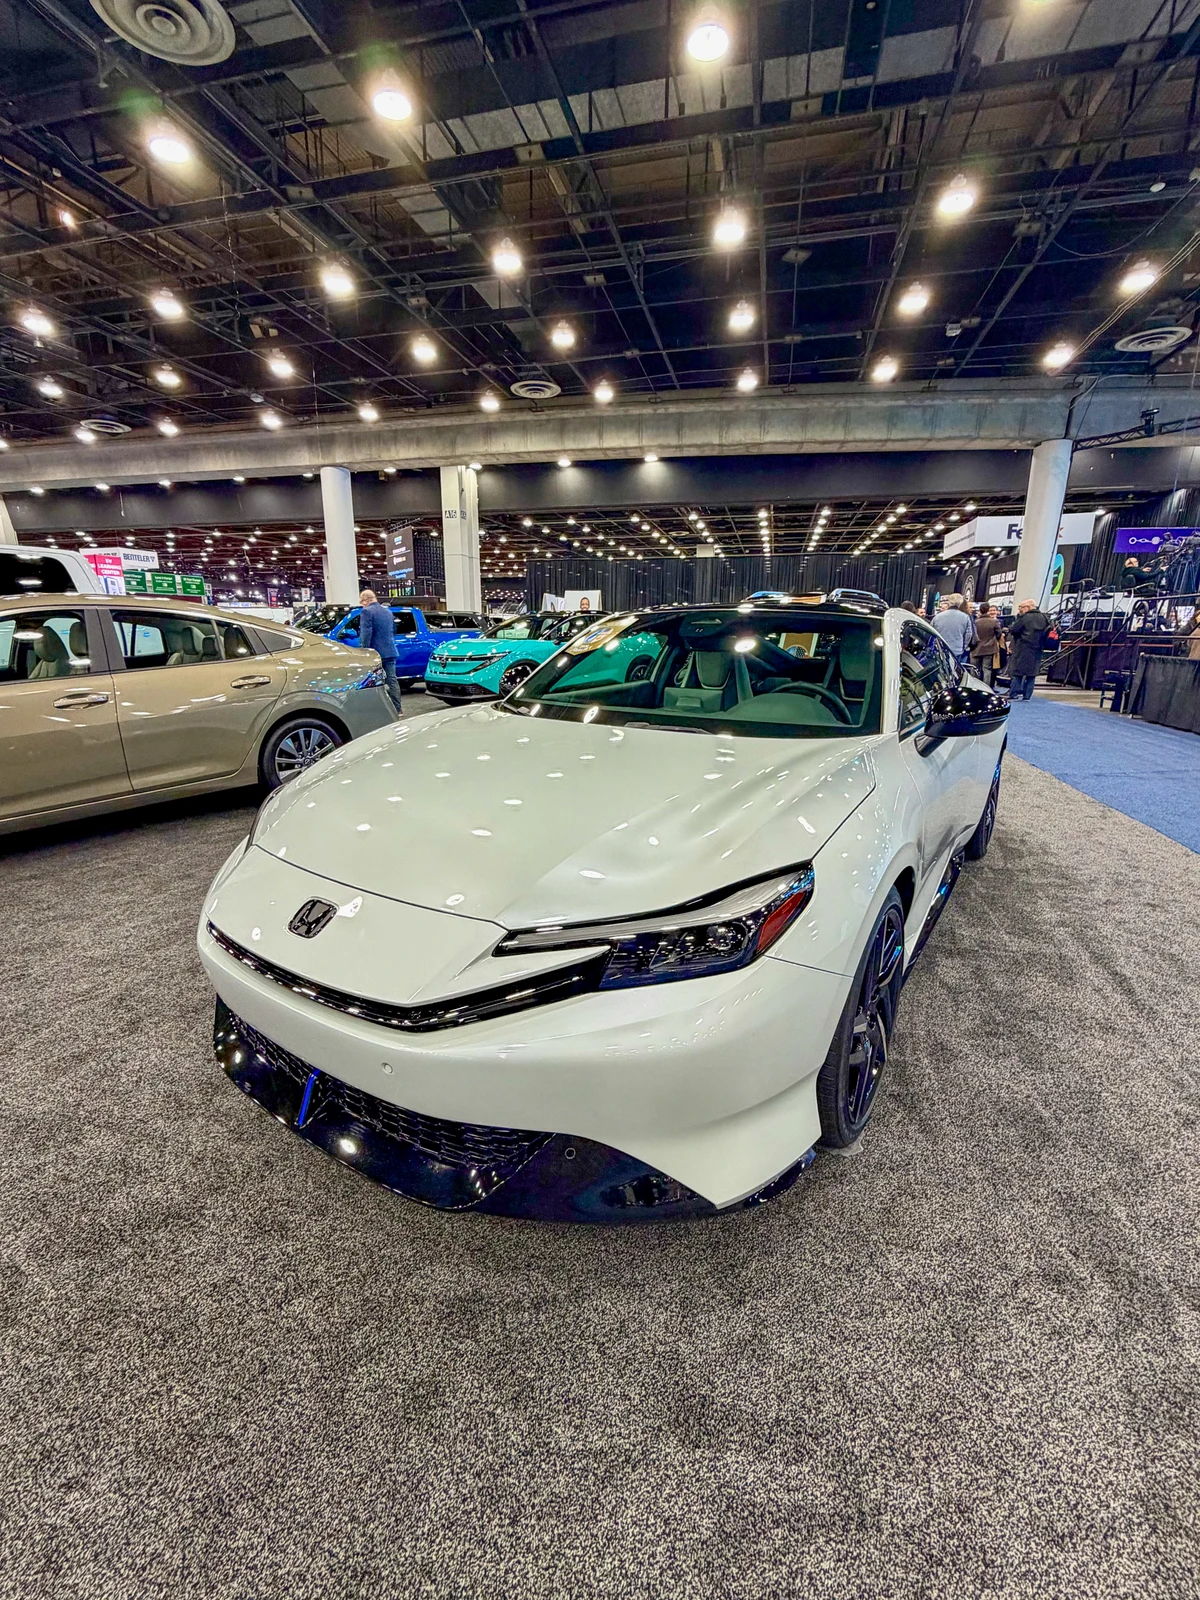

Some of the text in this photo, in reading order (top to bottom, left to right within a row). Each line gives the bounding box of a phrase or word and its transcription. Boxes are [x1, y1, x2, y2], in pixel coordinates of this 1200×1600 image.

[123, 553, 150, 562] BENTELER
[1006, 570, 1016, 581] ONLY
[996, 583, 1008, 593] MOTOR
